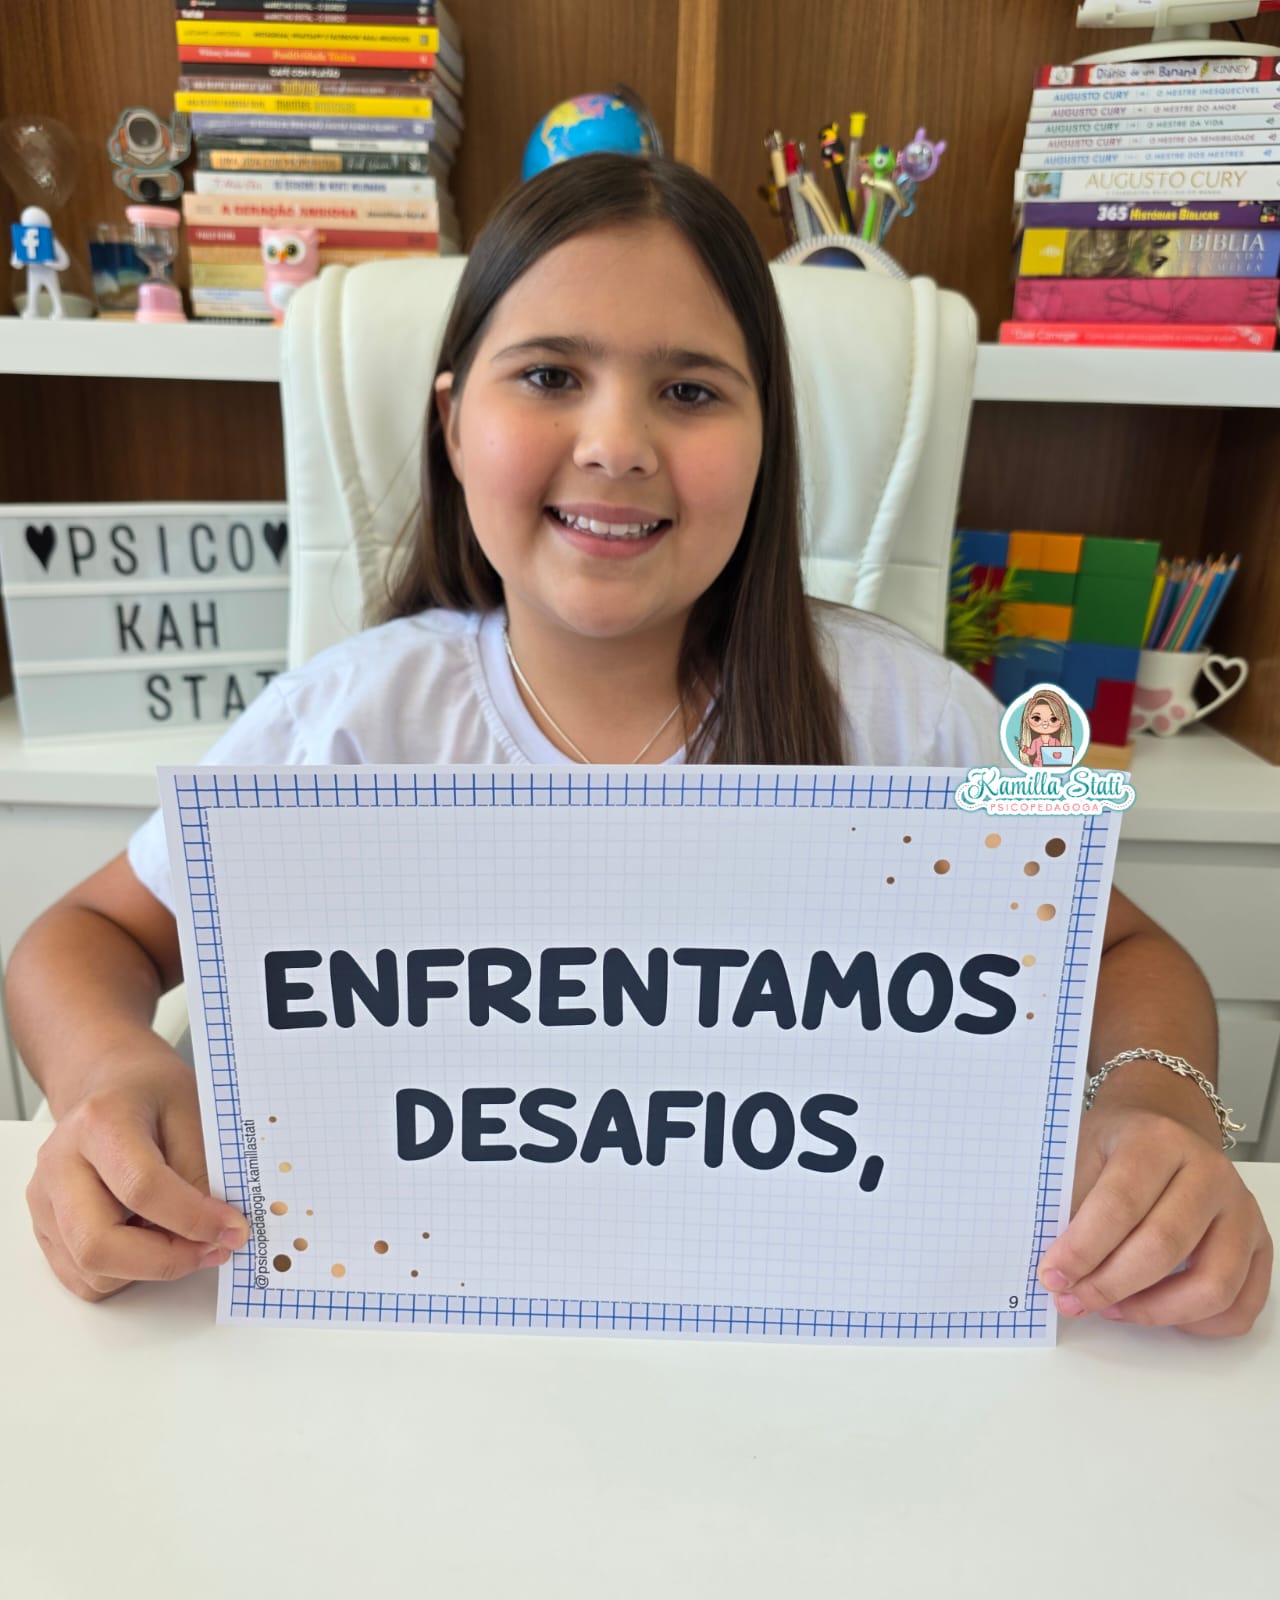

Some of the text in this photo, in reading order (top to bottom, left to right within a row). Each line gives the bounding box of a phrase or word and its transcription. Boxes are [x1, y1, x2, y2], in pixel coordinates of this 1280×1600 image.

[1096, 64, 1126, 79] Diário
[1159, 64, 1197, 78] Banana
[1054, 91, 1100, 101] AUGUSTO
[1103, 90, 1129, 100] CURY
[1052, 108, 1098, 118] AUGUSTO
[1100, 107, 1126, 116] CURY
[1045, 124, 1092, 133] AUGUSTO
[1094, 122, 1120, 131] CURY
[1048, 139, 1094, 148] AUGUSTO
[1096, 137, 1122, 146] CURY
[1043, 155, 1089, 165] AUGUSTO
[1092, 154, 1119, 163] CURY
[1085, 170, 1247, 189] AUGUSTO CURY
[1097, 206, 1128, 221] 365
[1190, 229, 1265, 251] BÍBLIA
[68, 523, 255, 576] PSICO
[116, 601, 219, 651] KAH
[264, 947, 1022, 1034] ENFRENTAMOS
[396, 1087, 885, 1192] DESAFIOS,
[242, 1119, 270, 1289] @psicopedagogia.kamillastati
[1009, 1295, 1018, 1309] 9
